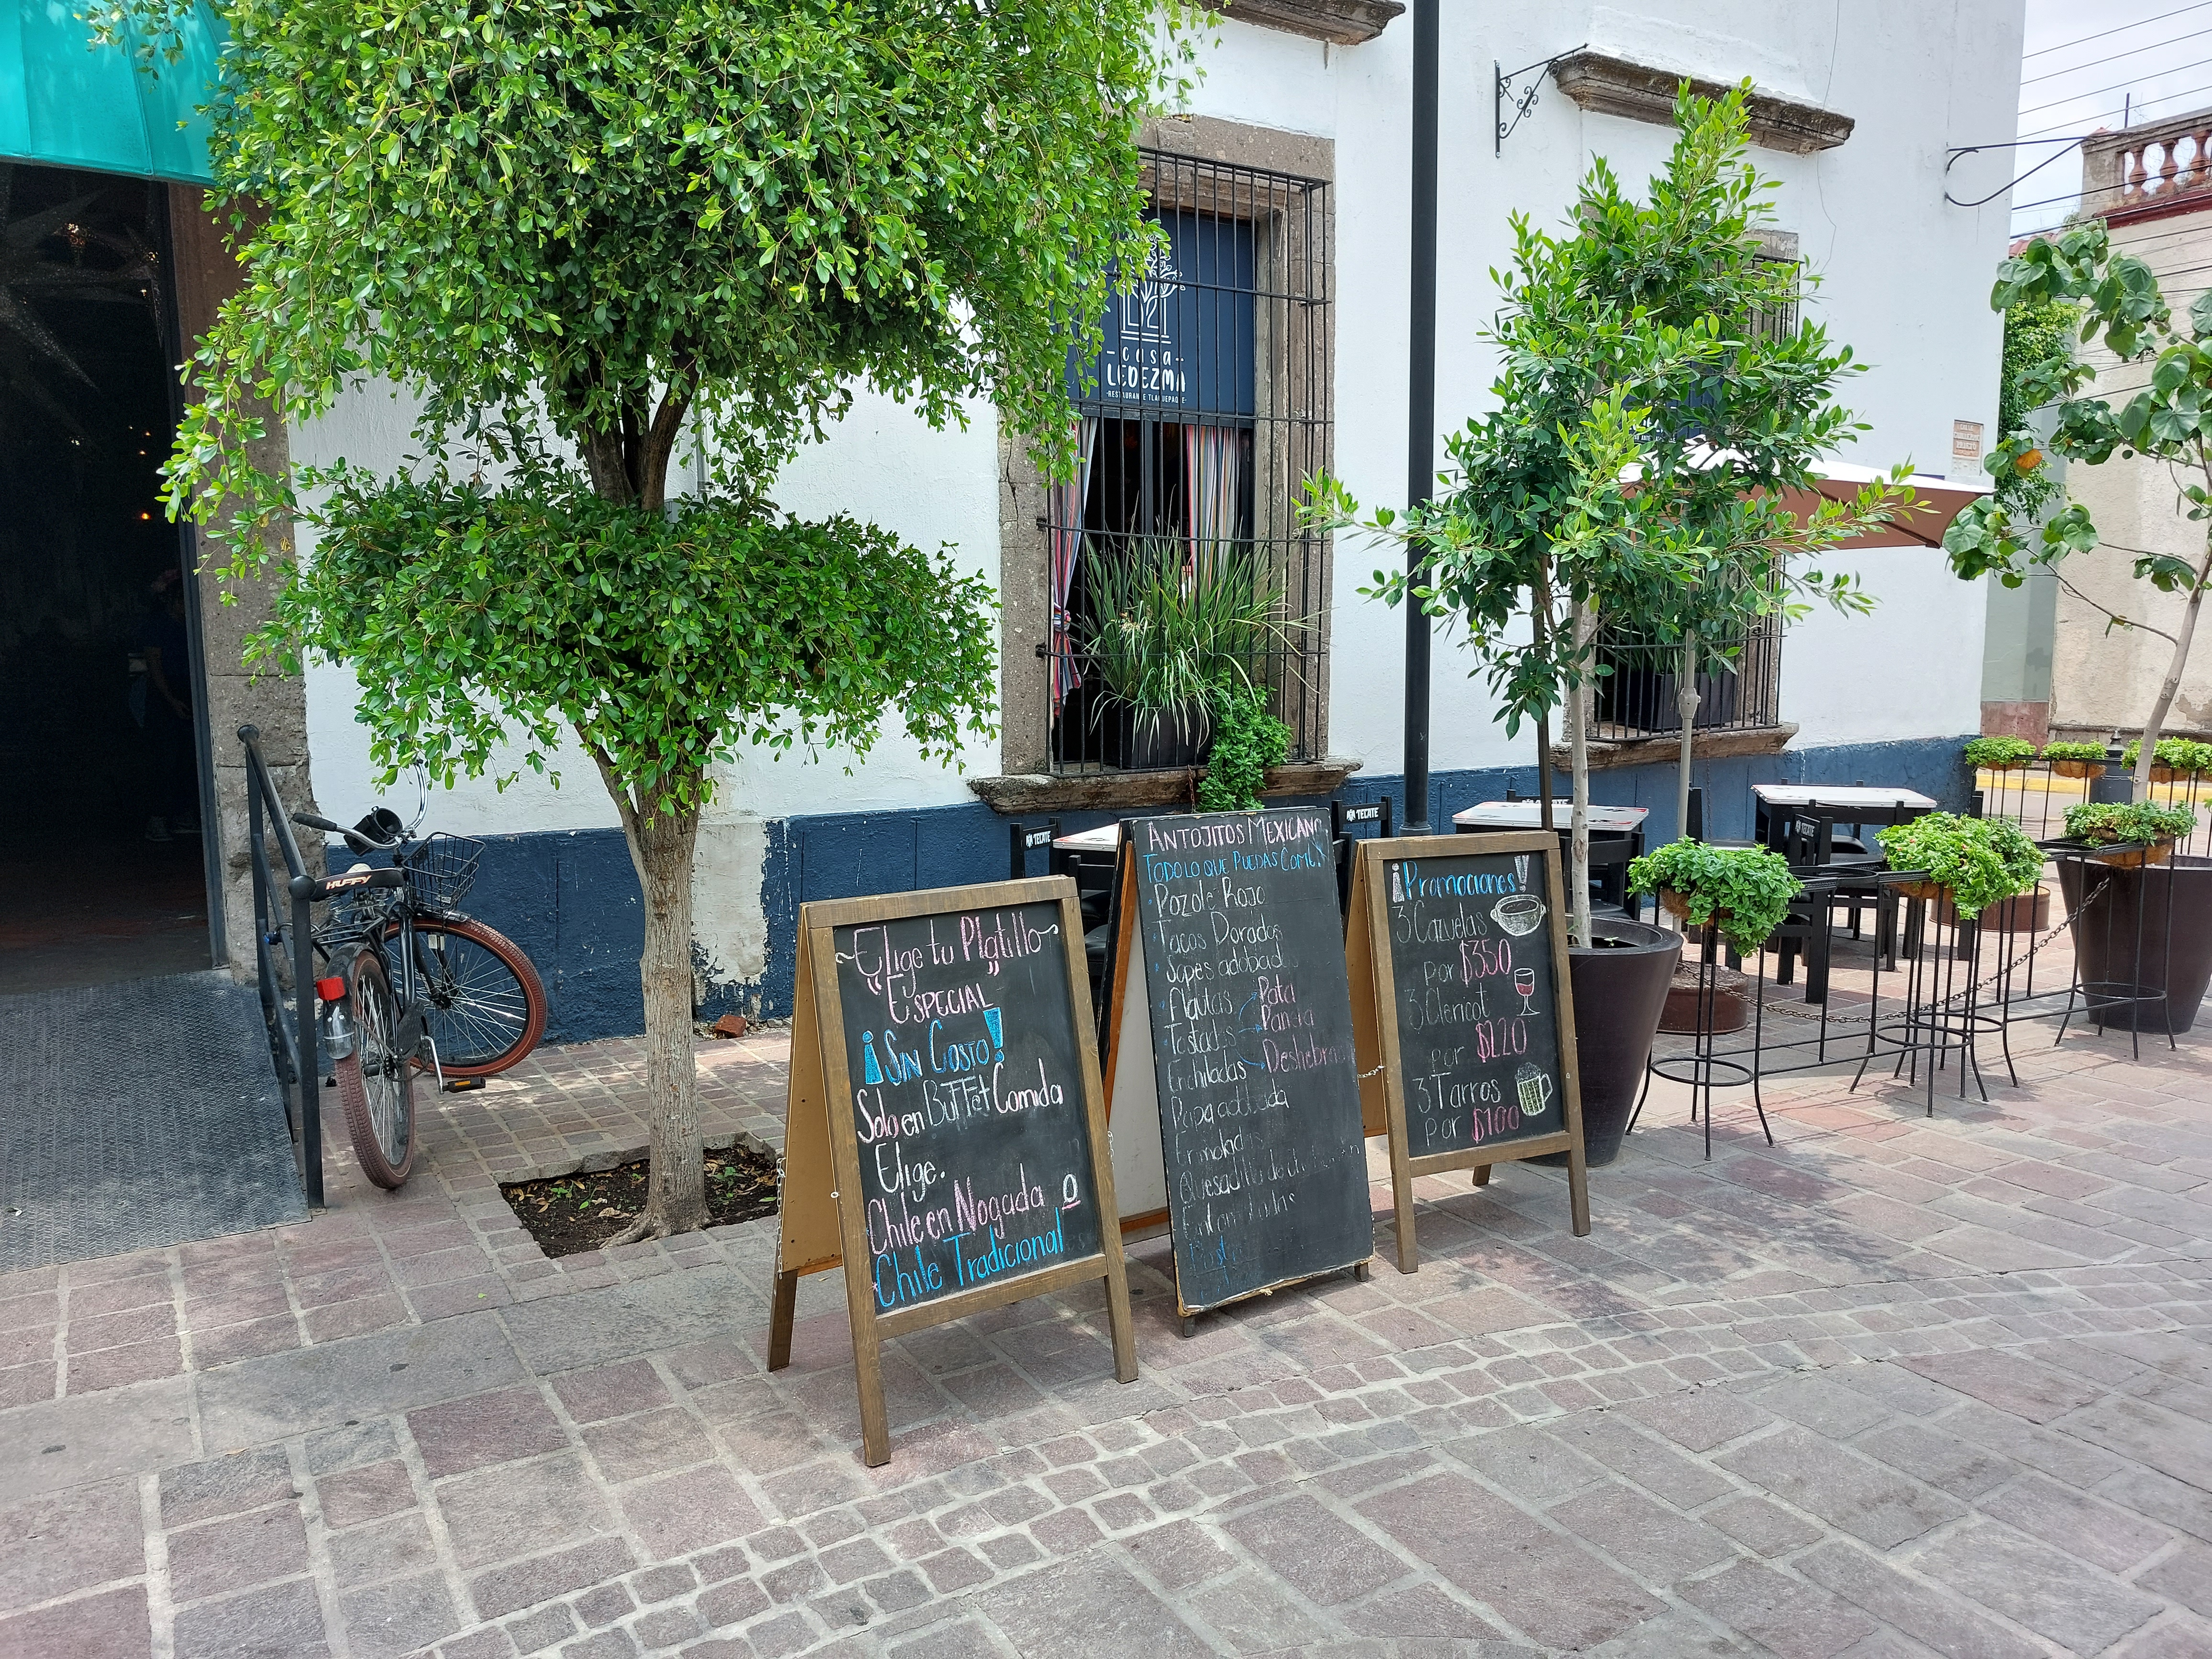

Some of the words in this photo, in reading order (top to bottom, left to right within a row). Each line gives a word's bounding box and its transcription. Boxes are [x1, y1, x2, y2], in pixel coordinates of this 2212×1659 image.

[1107, 363, 1185, 392] LEDEZMA
[1108, 390, 1146, 400] RESTURANE
[1148, 394, 1185, 404] TLAUEPAQE
[1356, 807, 1379, 819] TECATE
[1033, 830, 1051, 845] TECATE
[1148, 821, 1245, 852] ANTOJITOS
[326, 875, 372, 890] HUFFY
[1154, 880, 1217, 918] Pozole
[927, 919, 954, 965] tu
[960, 911, 1041, 962] Platillo
[1151, 919, 1207, 954] Tacos
[1391, 905, 1411, 943] 3
[1414, 899, 1488, 944] Cazuelas
[1166, 954, 1215, 991] Sopes
[1459, 938, 1512, 988] $350
[1404, 989, 1424, 1030] 3
[857, 1087, 899, 1144] Solo
[901, 1111, 927, 1137] en
[993, 1058, 1064, 1114] Comida
[1412, 1077, 1431, 1114] 3
[1429, 1072, 1502, 1109] Tarros
[1471, 1105, 1520, 1144] $100
[867, 1192, 924, 1254] Chile
[926, 1204, 953, 1239] en
[954, 1163, 1046, 1239] Nogada
[876, 1245, 943, 1307] Chile
[943, 1207, 1065, 1287] Tradicional
